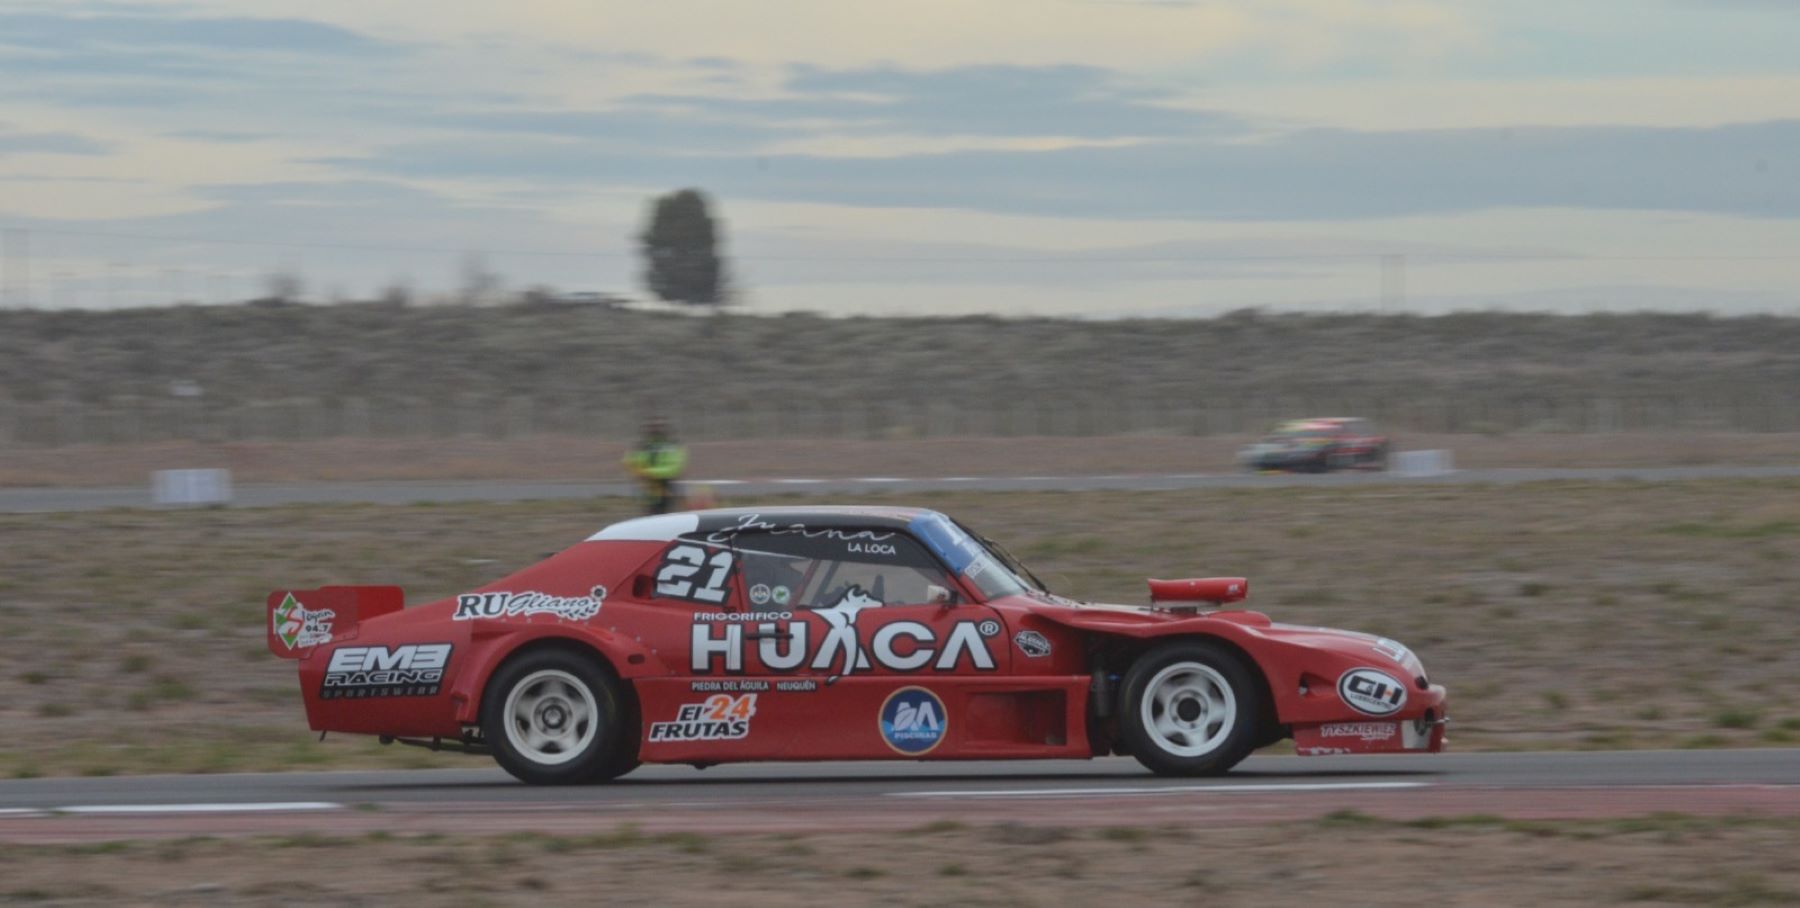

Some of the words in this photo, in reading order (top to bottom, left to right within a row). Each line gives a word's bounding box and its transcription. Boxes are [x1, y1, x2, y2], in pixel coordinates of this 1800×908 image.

[847, 542, 863, 553] LA
[865, 543, 897, 555] LOCA
[657, 545, 733, 602] 21
[694, 611, 793, 621] FRIGORIFICO
[324, 668, 443, 686] RACING
[692, 682, 721, 691] PIEDRA
[723, 682, 738, 691] DEL
[1347, 675, 1403, 706] GH
[709, 696, 752, 720] 24
[650, 720, 748, 740] FRUTAS
